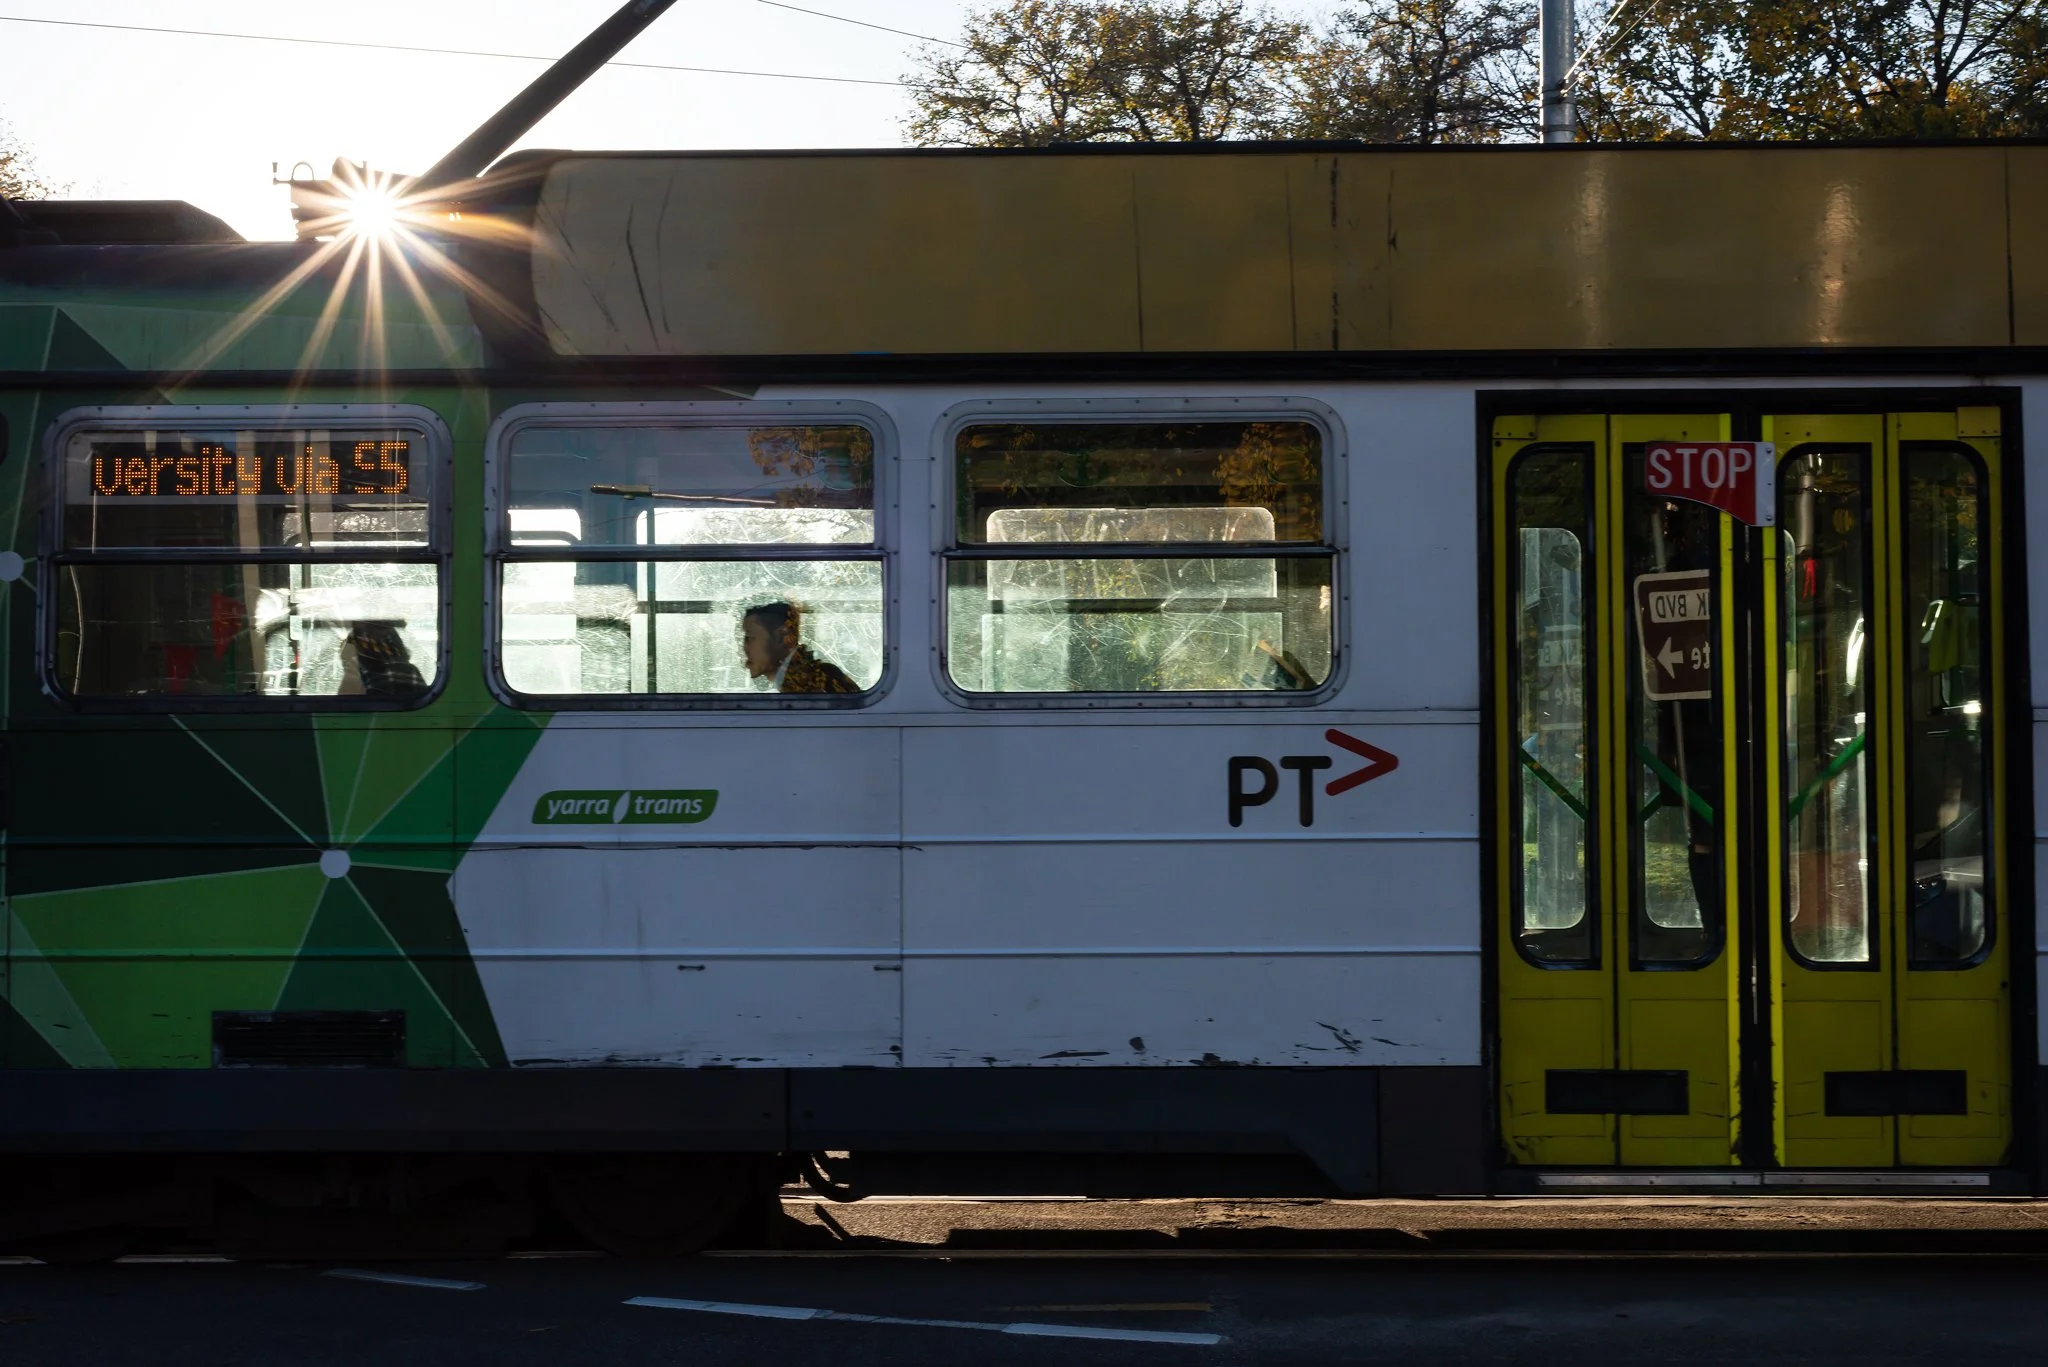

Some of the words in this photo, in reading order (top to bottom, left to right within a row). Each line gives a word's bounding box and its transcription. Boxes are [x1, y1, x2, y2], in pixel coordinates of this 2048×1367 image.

[95, 446, 262, 495] versity
[276, 446, 340, 495] via
[1648, 447, 1753, 490] STOP
[547, 798, 610, 820] yarra
[635, 795, 703, 815] trams
